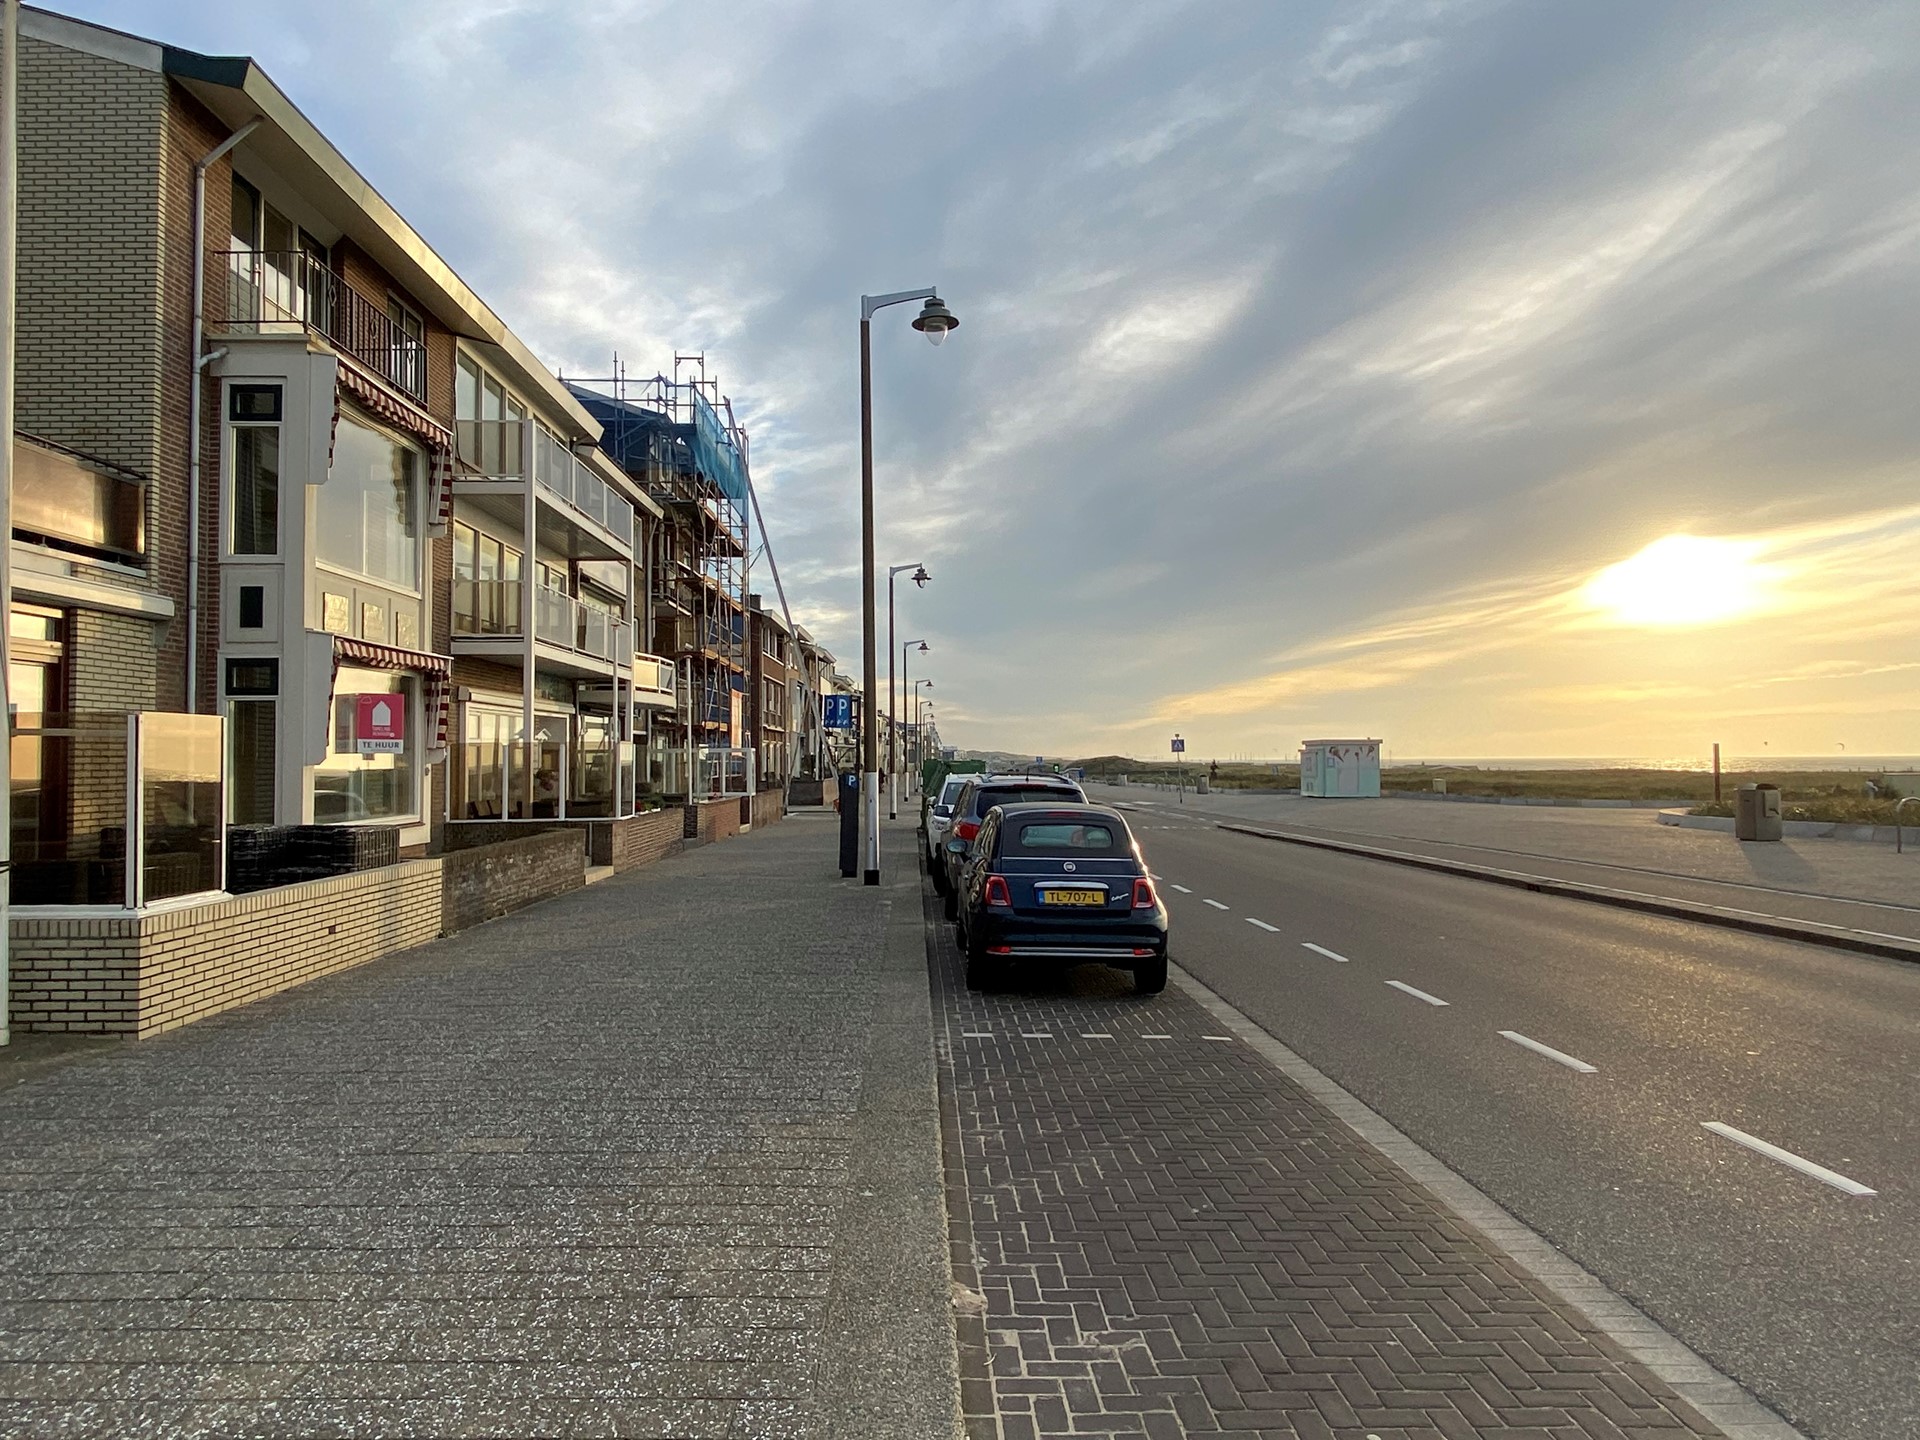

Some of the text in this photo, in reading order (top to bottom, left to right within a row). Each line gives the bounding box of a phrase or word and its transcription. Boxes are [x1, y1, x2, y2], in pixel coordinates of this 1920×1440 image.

[826, 699, 834, 716] P
[839, 699, 847, 716] P
[849, 775, 856, 786] P
[1049, 892, 1098, 902] TL-707-L
